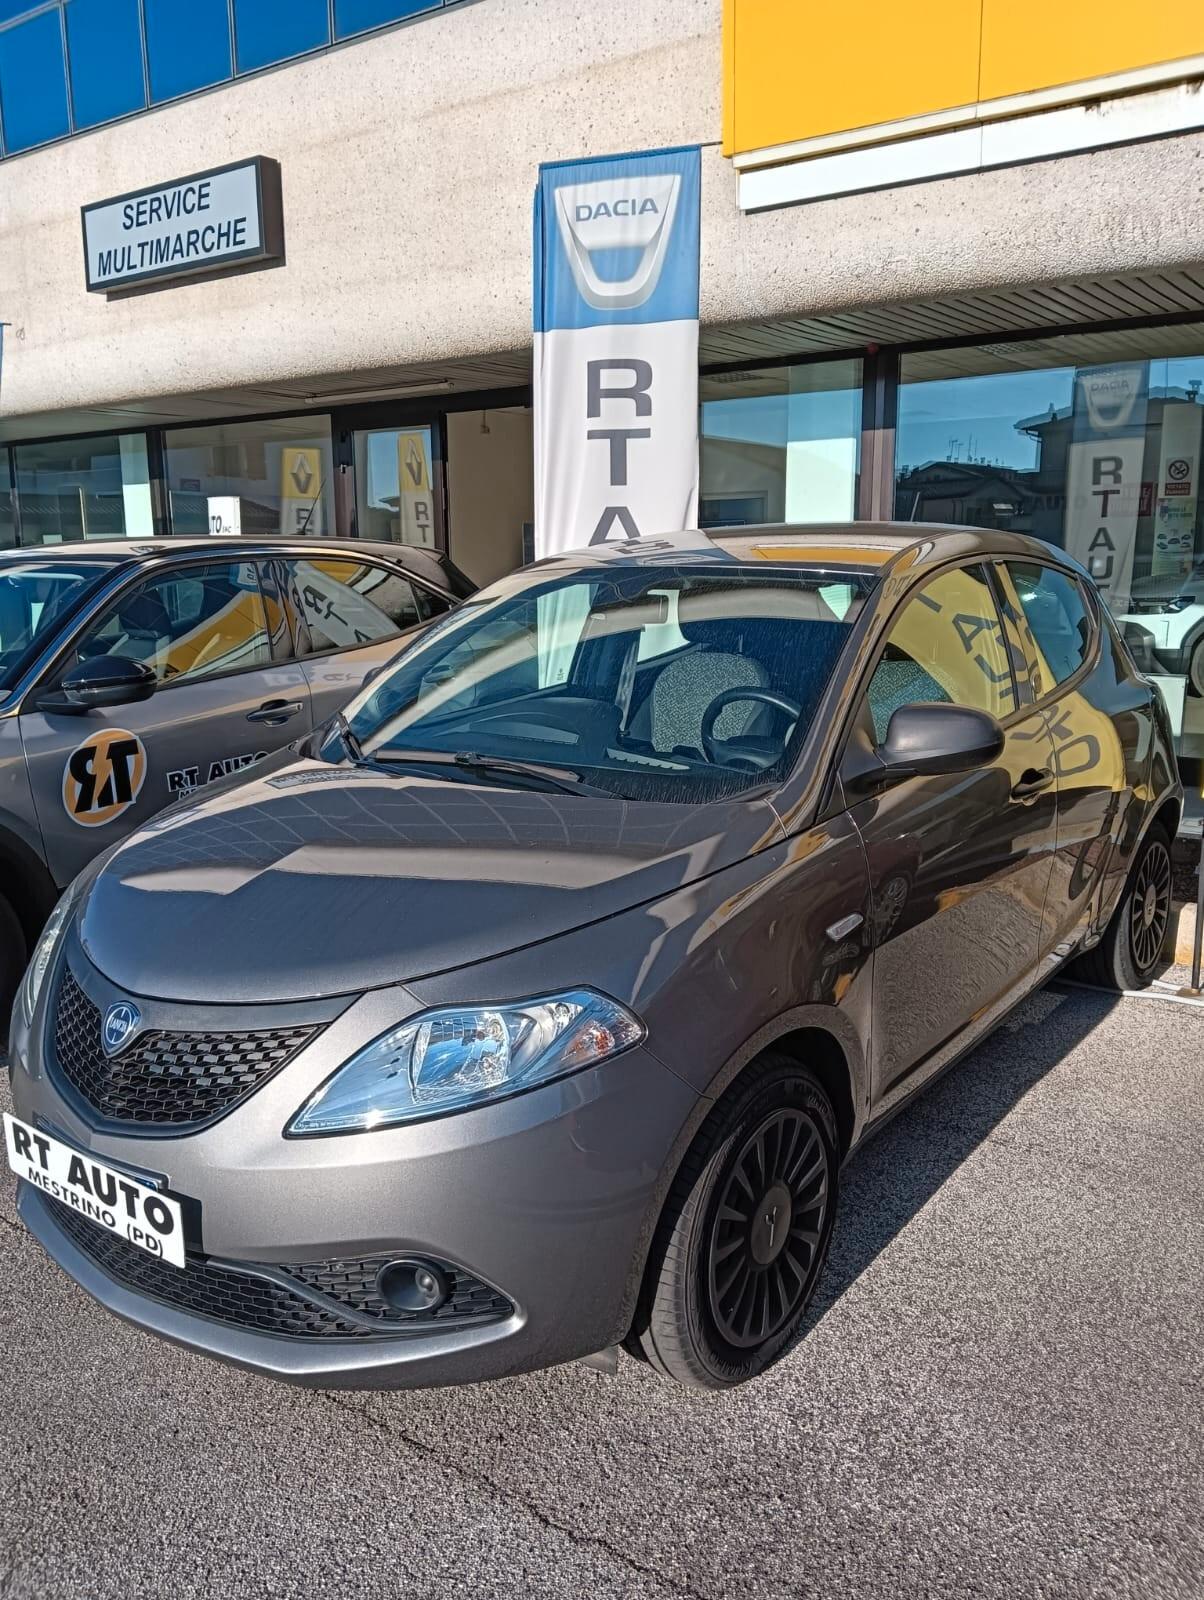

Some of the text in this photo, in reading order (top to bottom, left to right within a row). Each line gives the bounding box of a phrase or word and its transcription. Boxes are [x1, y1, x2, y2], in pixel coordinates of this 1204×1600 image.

[122, 182, 211, 230] SERVICE
[575, 197, 659, 222] DACIA
[97, 217, 247, 277] MULTIMARCHE
[167, 766, 199, 792] RT
[12, 1122, 174, 1236] RT AUTO
[28, 1167, 164, 1259] MESTRINO (PD)
